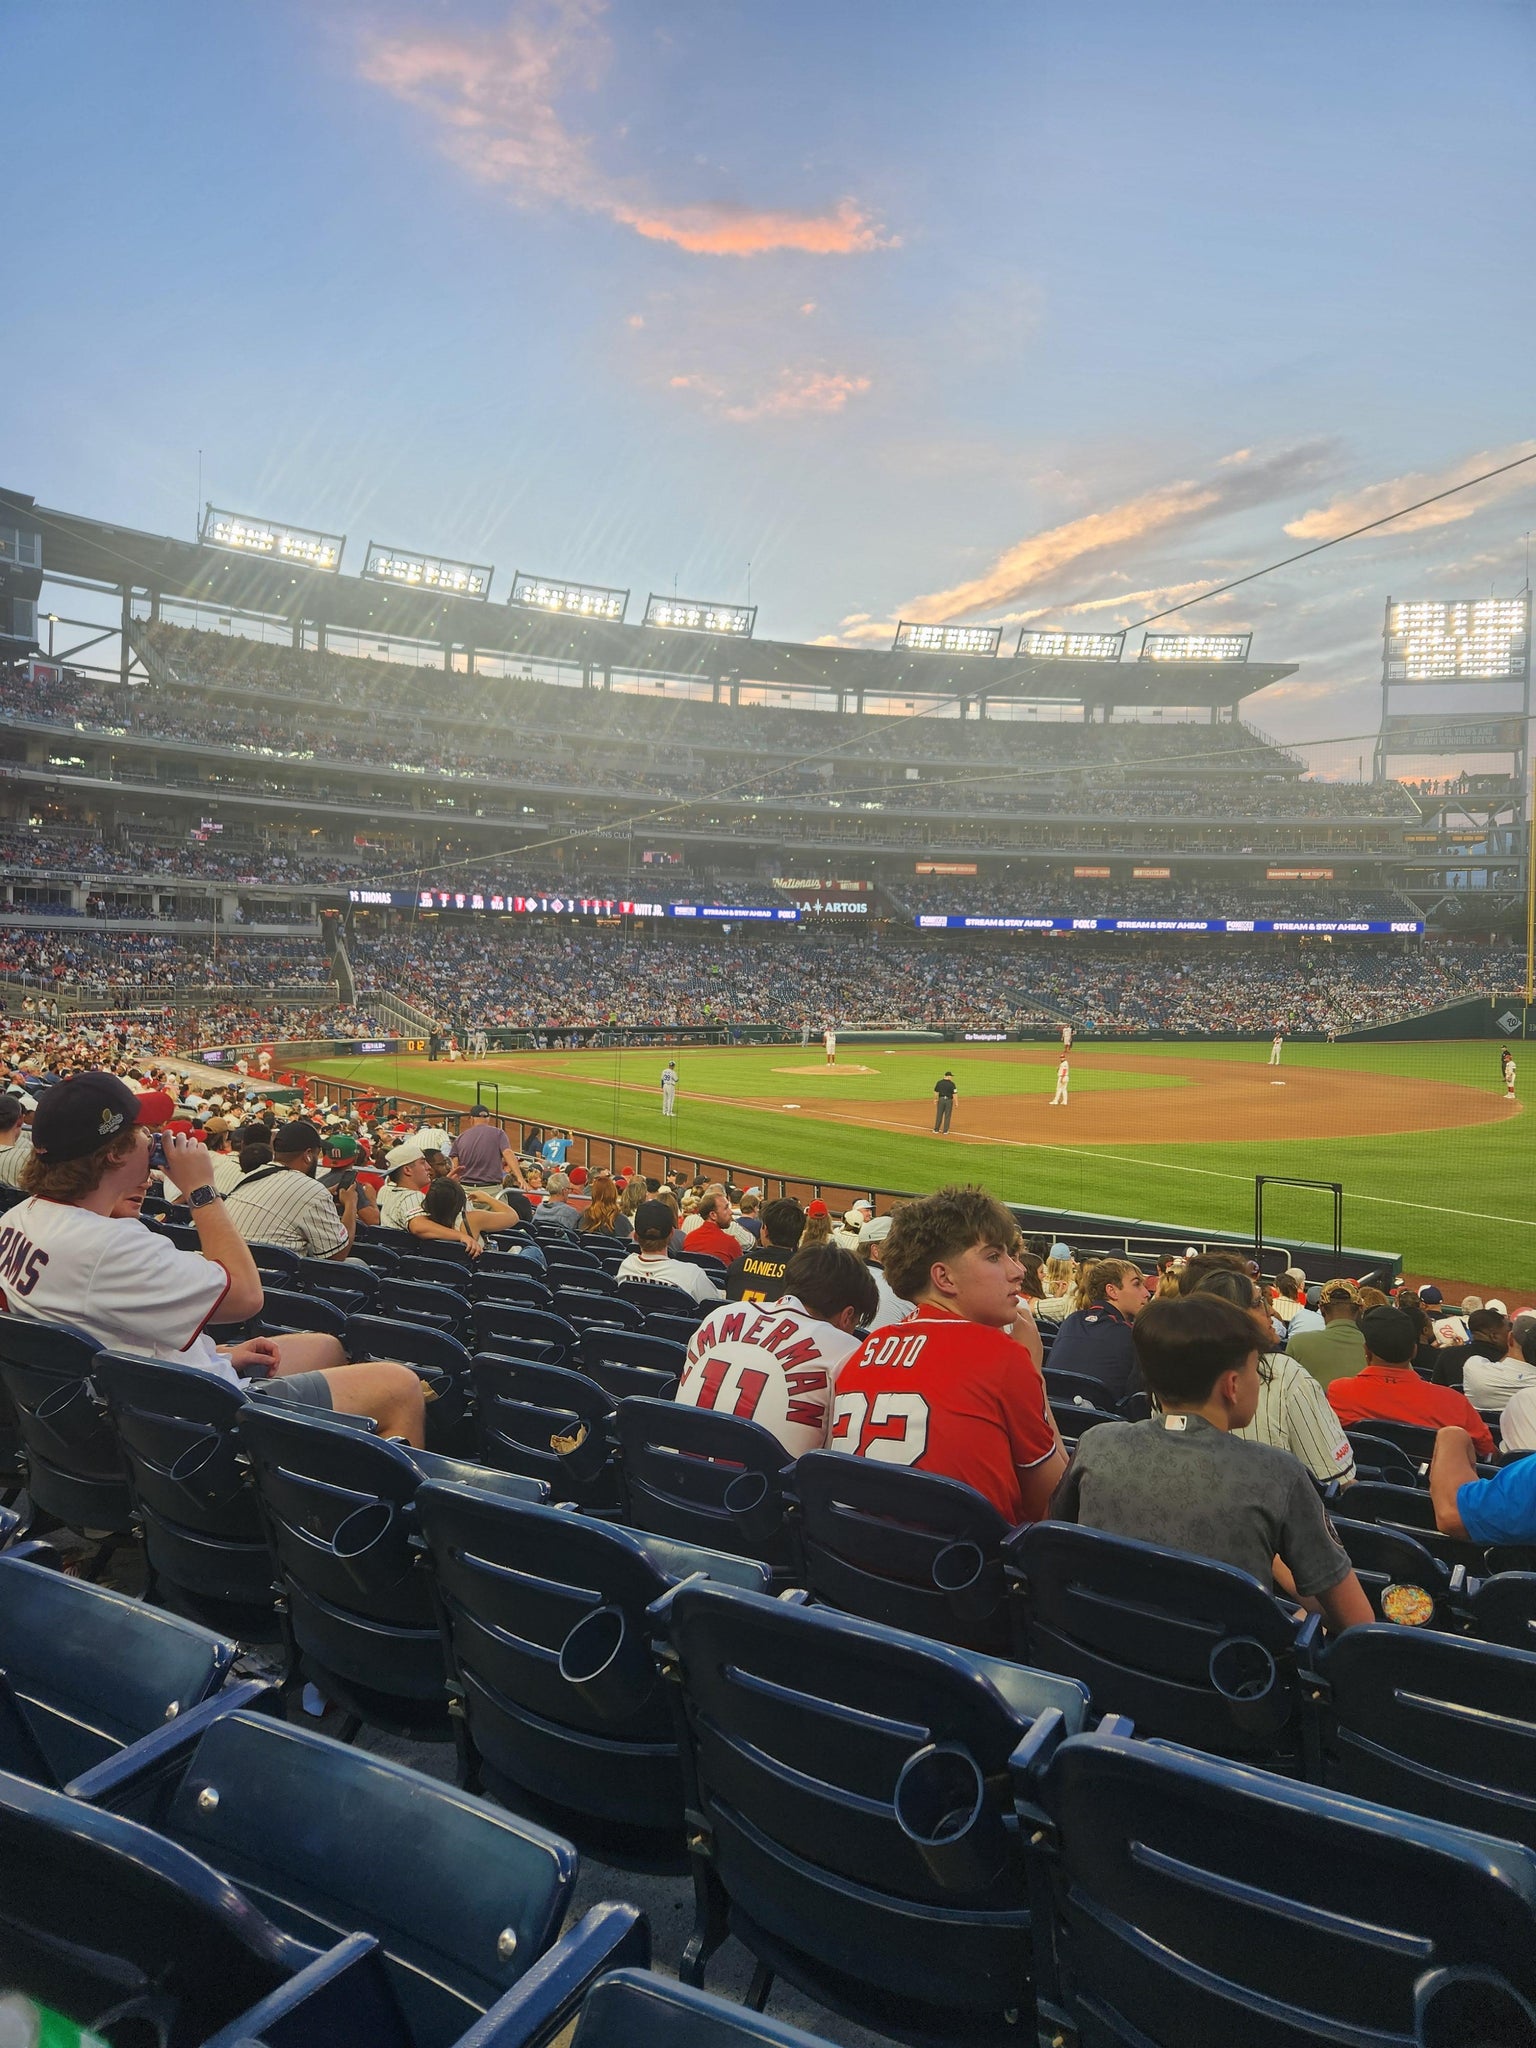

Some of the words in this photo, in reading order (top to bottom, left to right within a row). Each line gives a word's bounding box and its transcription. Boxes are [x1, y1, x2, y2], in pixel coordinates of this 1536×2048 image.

[360, 891, 392, 904] THOMAS
[825, 902, 868, 914] ARTOIS
[965, 918, 997, 927] STREAM
[1005, 919, 1024, 927] STAY
[1024, 919, 1053, 928] AHEAD
[1072, 919, 1089, 929] FOX
[1089, 919, 1098, 929] 5
[1117, 920, 1149, 929] STREAM
[1157, 921, 1177, 929] STAY
[1177, 921, 1208, 930] AHEAD
[1273, 923, 1308, 931] STREAM
[1316, 923, 1337, 931] STAY
[1337, 923, 1369, 931] AHEAD
[1391, 922, 1409, 932] FOX
[1409, 923, 1417, 932] 5
[550, 1146, 559, 1158] 7
[743, 1257, 786, 1278] DANIELS
[859, 1334, 928, 1369] SOTO
[696, 1357, 770, 1421] 11
